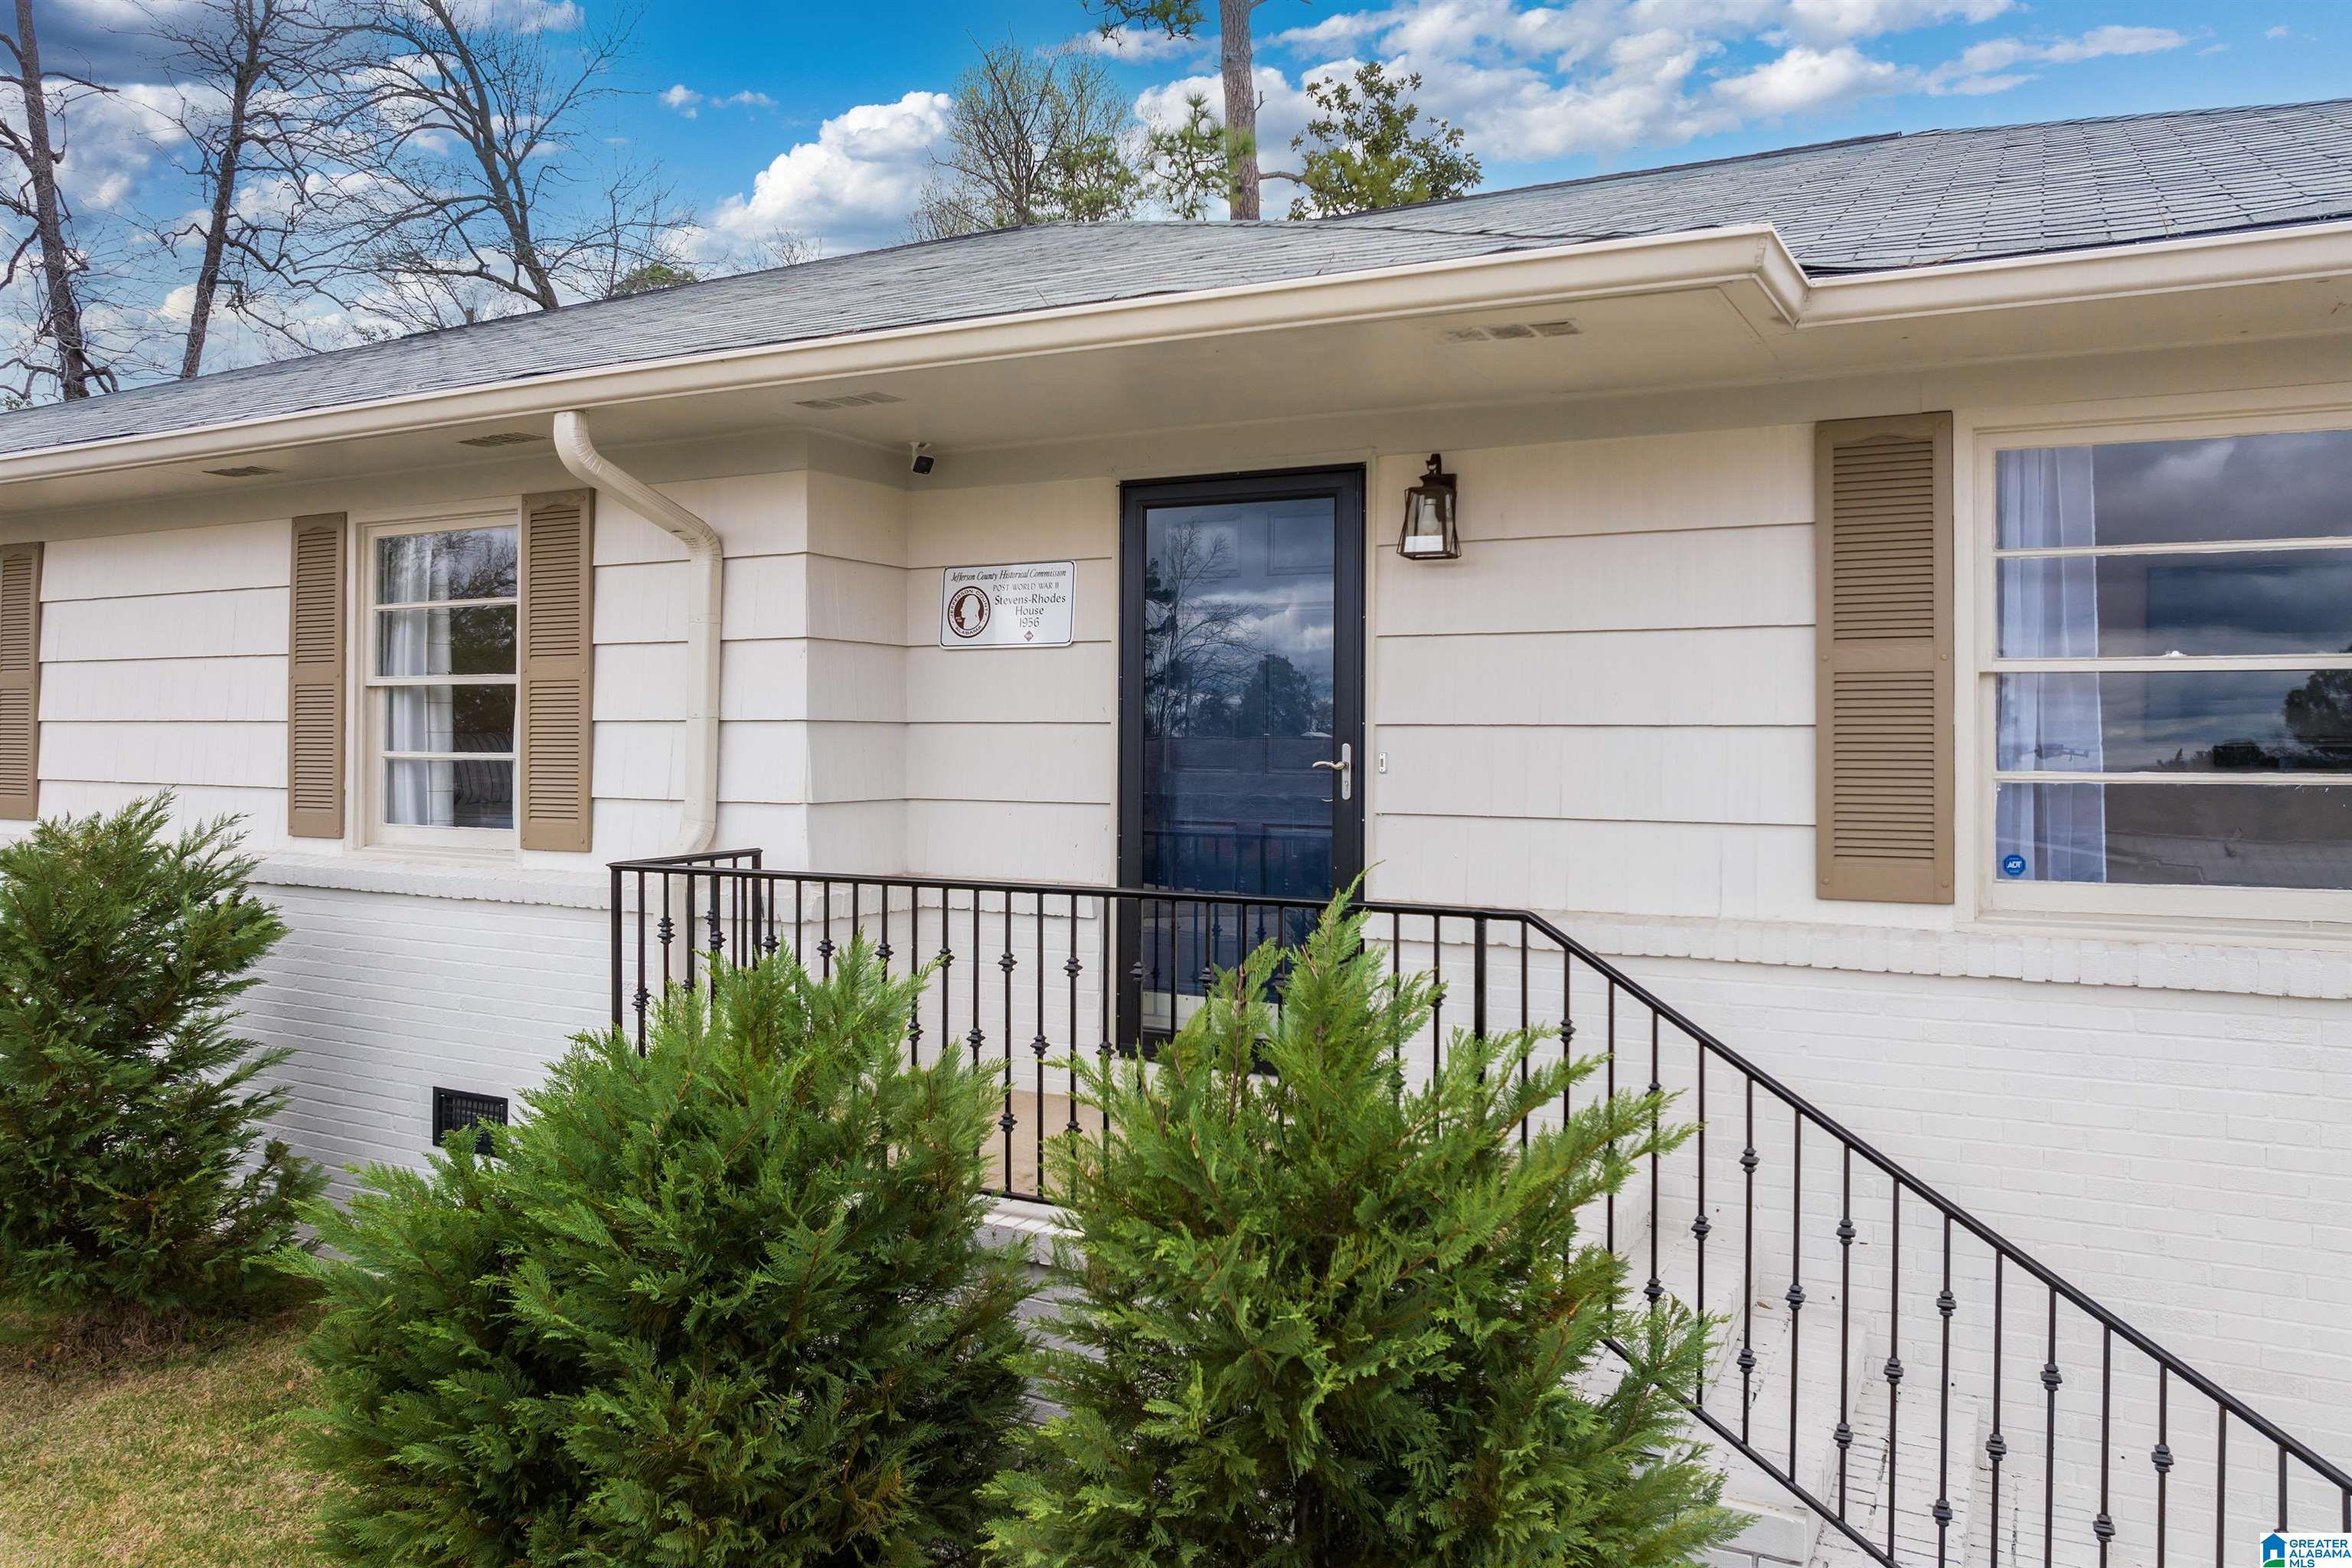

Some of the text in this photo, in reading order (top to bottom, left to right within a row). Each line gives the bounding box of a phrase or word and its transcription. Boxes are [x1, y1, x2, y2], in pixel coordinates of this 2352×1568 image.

[951, 569, 1067, 583] Jefferson County Historical Commission
[993, 583, 1009, 592] POST
[1011, 583, 1036, 591] WORLD
[995, 593, 1066, 605] Stevens-Rhodes
[1015, 606, 1044, 616] House
[1019, 617, 1040, 628] 1956
[955, 626, 982, 635] ALABAMA
[2007, 861, 2022, 869] ADT
